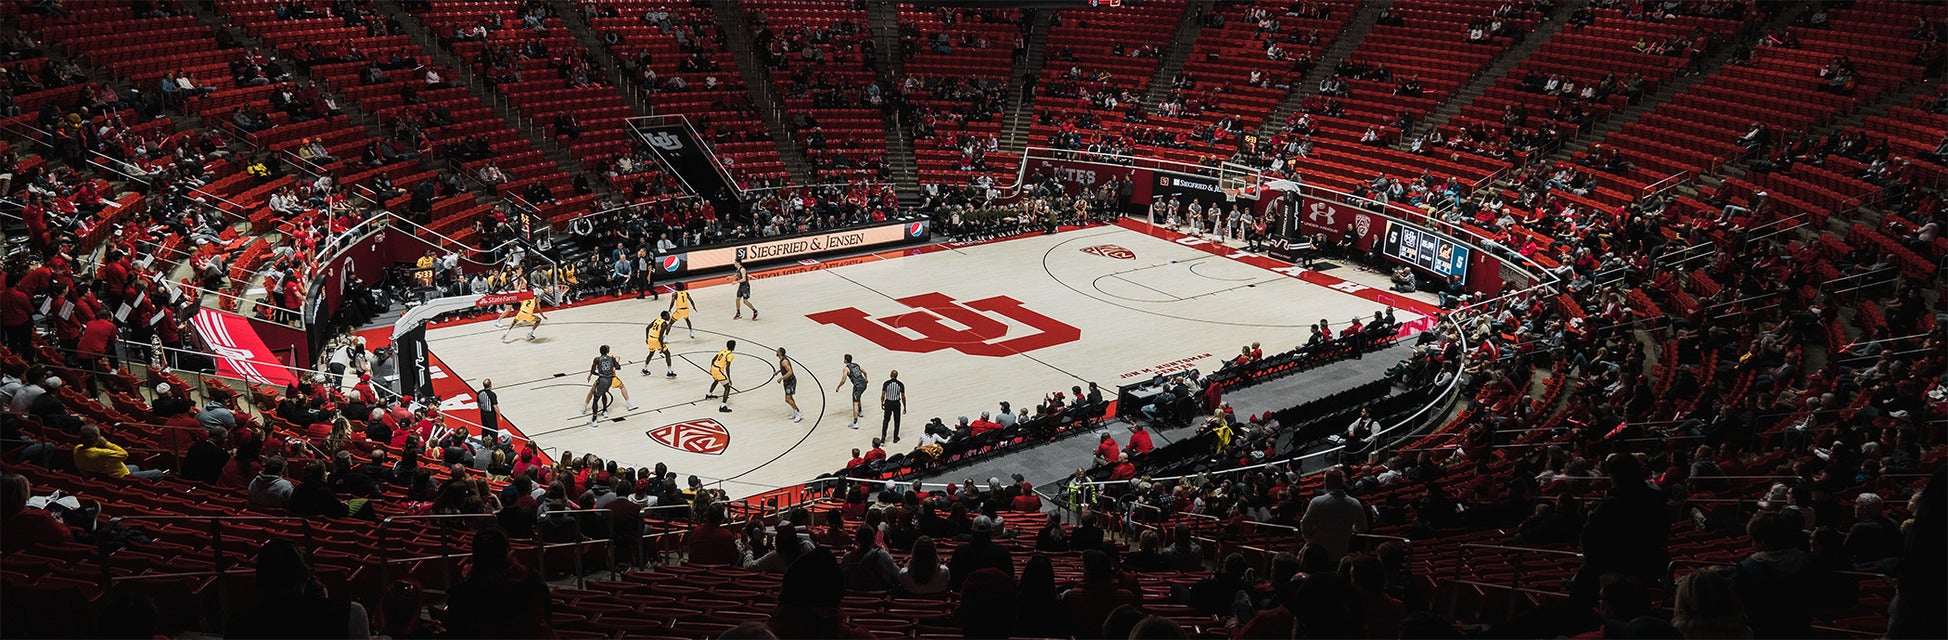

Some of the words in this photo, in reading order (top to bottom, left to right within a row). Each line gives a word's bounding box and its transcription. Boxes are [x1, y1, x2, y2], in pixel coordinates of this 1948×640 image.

[749, 239, 808, 259] SIEGFRIED
[809, 237, 822, 252] &
[824, 232, 865, 251] JENSEN
